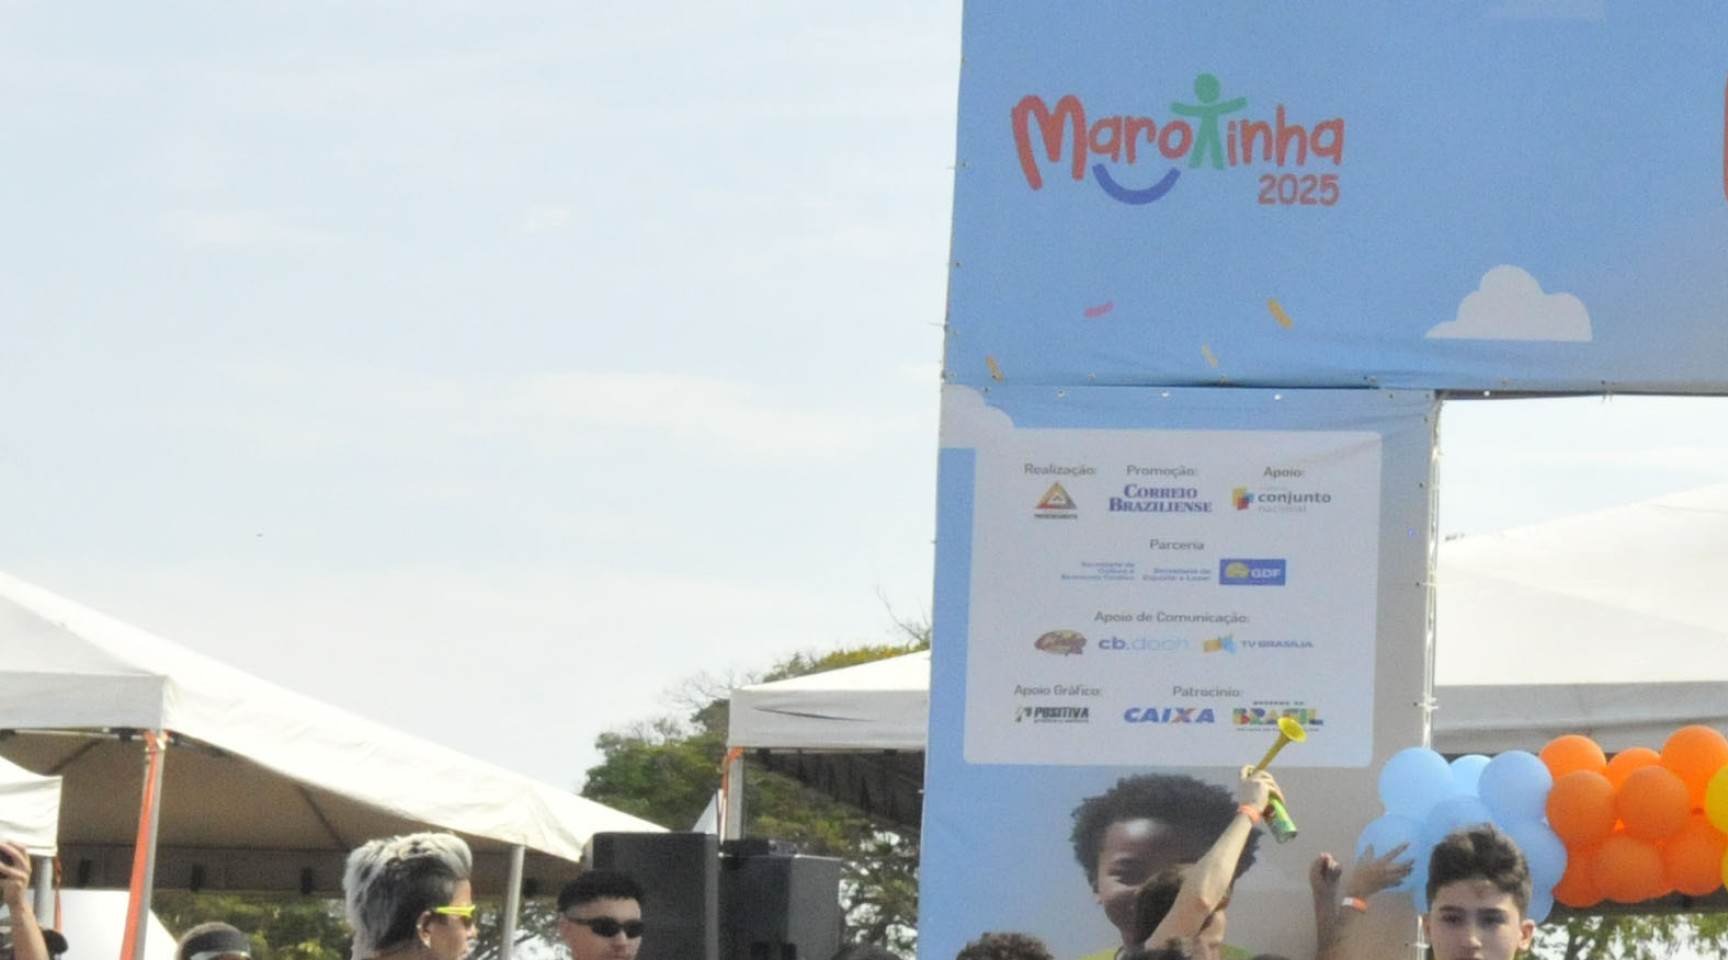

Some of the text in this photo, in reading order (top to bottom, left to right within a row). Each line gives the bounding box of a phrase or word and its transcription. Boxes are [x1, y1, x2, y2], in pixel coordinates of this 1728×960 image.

[1011, 72, 1346, 190] Marotinha
[1258, 174, 1340, 206] 2025
[1124, 483, 1198, 499] CORREIO
[1258, 491, 1331, 504] conjunto
[1109, 497, 1213, 512] BRAZILIENSE
[1150, 538, 1204, 550] Parceria
[1094, 611, 1133, 624] Apoio
[1136, 611, 1153, 622] de
[1014, 684, 1051, 697] Apoio
[1033, 706, 1089, 718] POSITIVA
[1123, 707, 1216, 723] CAIXA
